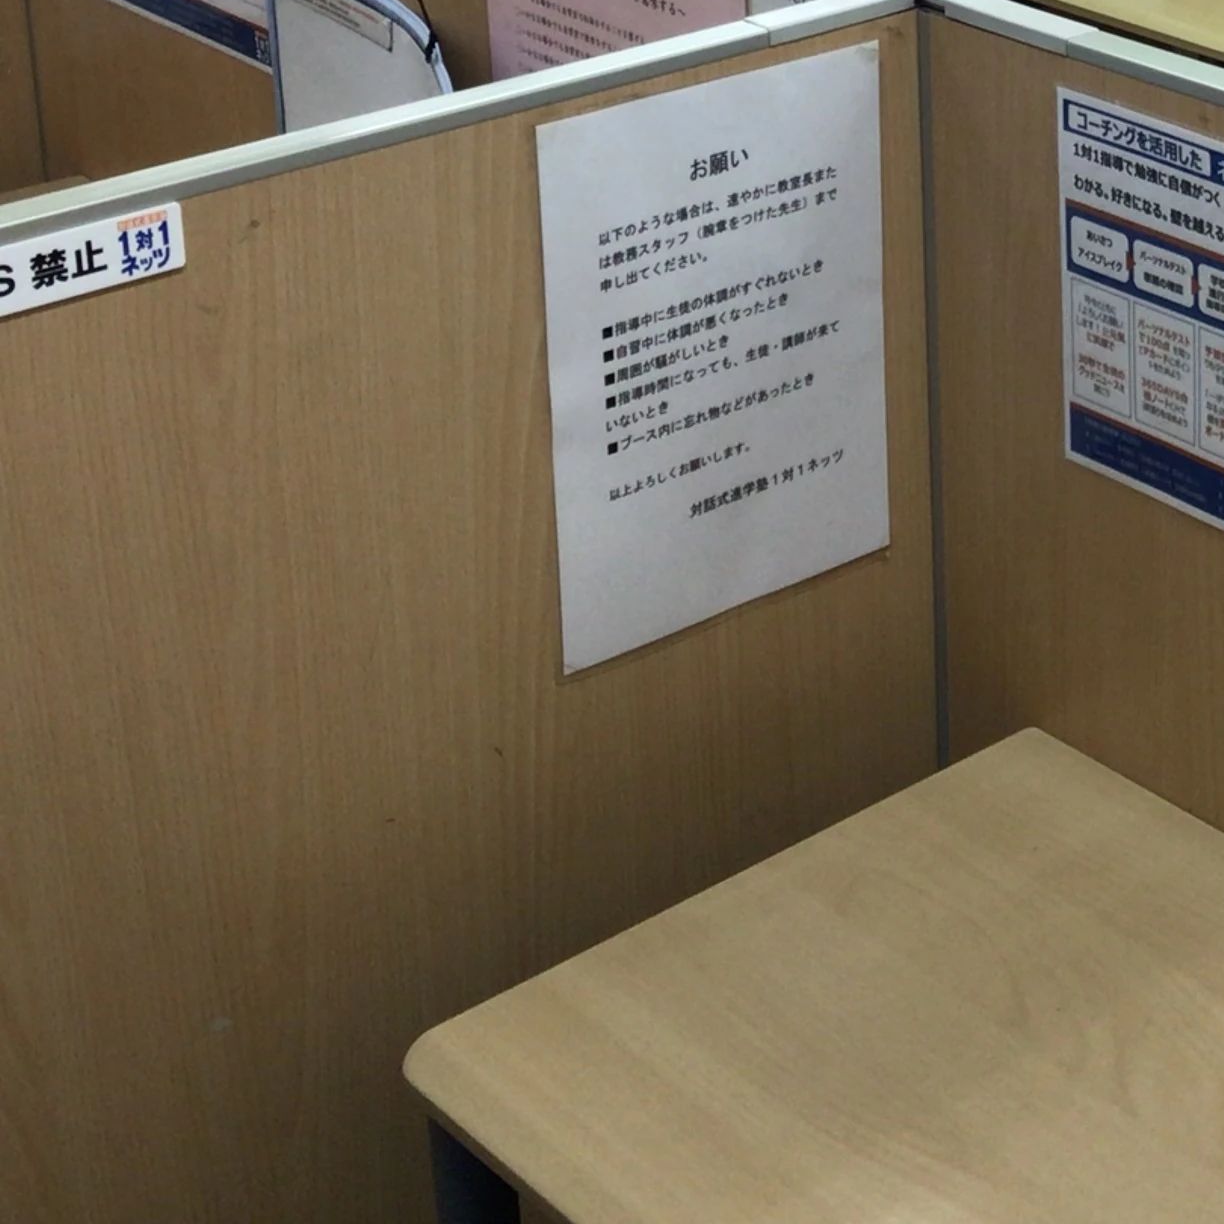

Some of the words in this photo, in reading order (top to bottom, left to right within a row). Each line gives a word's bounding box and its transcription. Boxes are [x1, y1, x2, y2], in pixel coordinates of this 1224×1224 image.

[1077, 111, 1203, 171] コーチングを活用した
[689, 149, 749, 181] お願い
[598, 165, 838, 247] 以下のような場合は、速やかに教室長また
[118, 220, 170, 257] 1対1
[30, 240, 108, 290] 禁止
[121, 246, 171, 276] ネッツ
[600, 252, 708, 293] 申し出てください。
[605, 401, 669, 432] いないとき
[609, 441, 751, 502] 以上よろしくお願いします。
